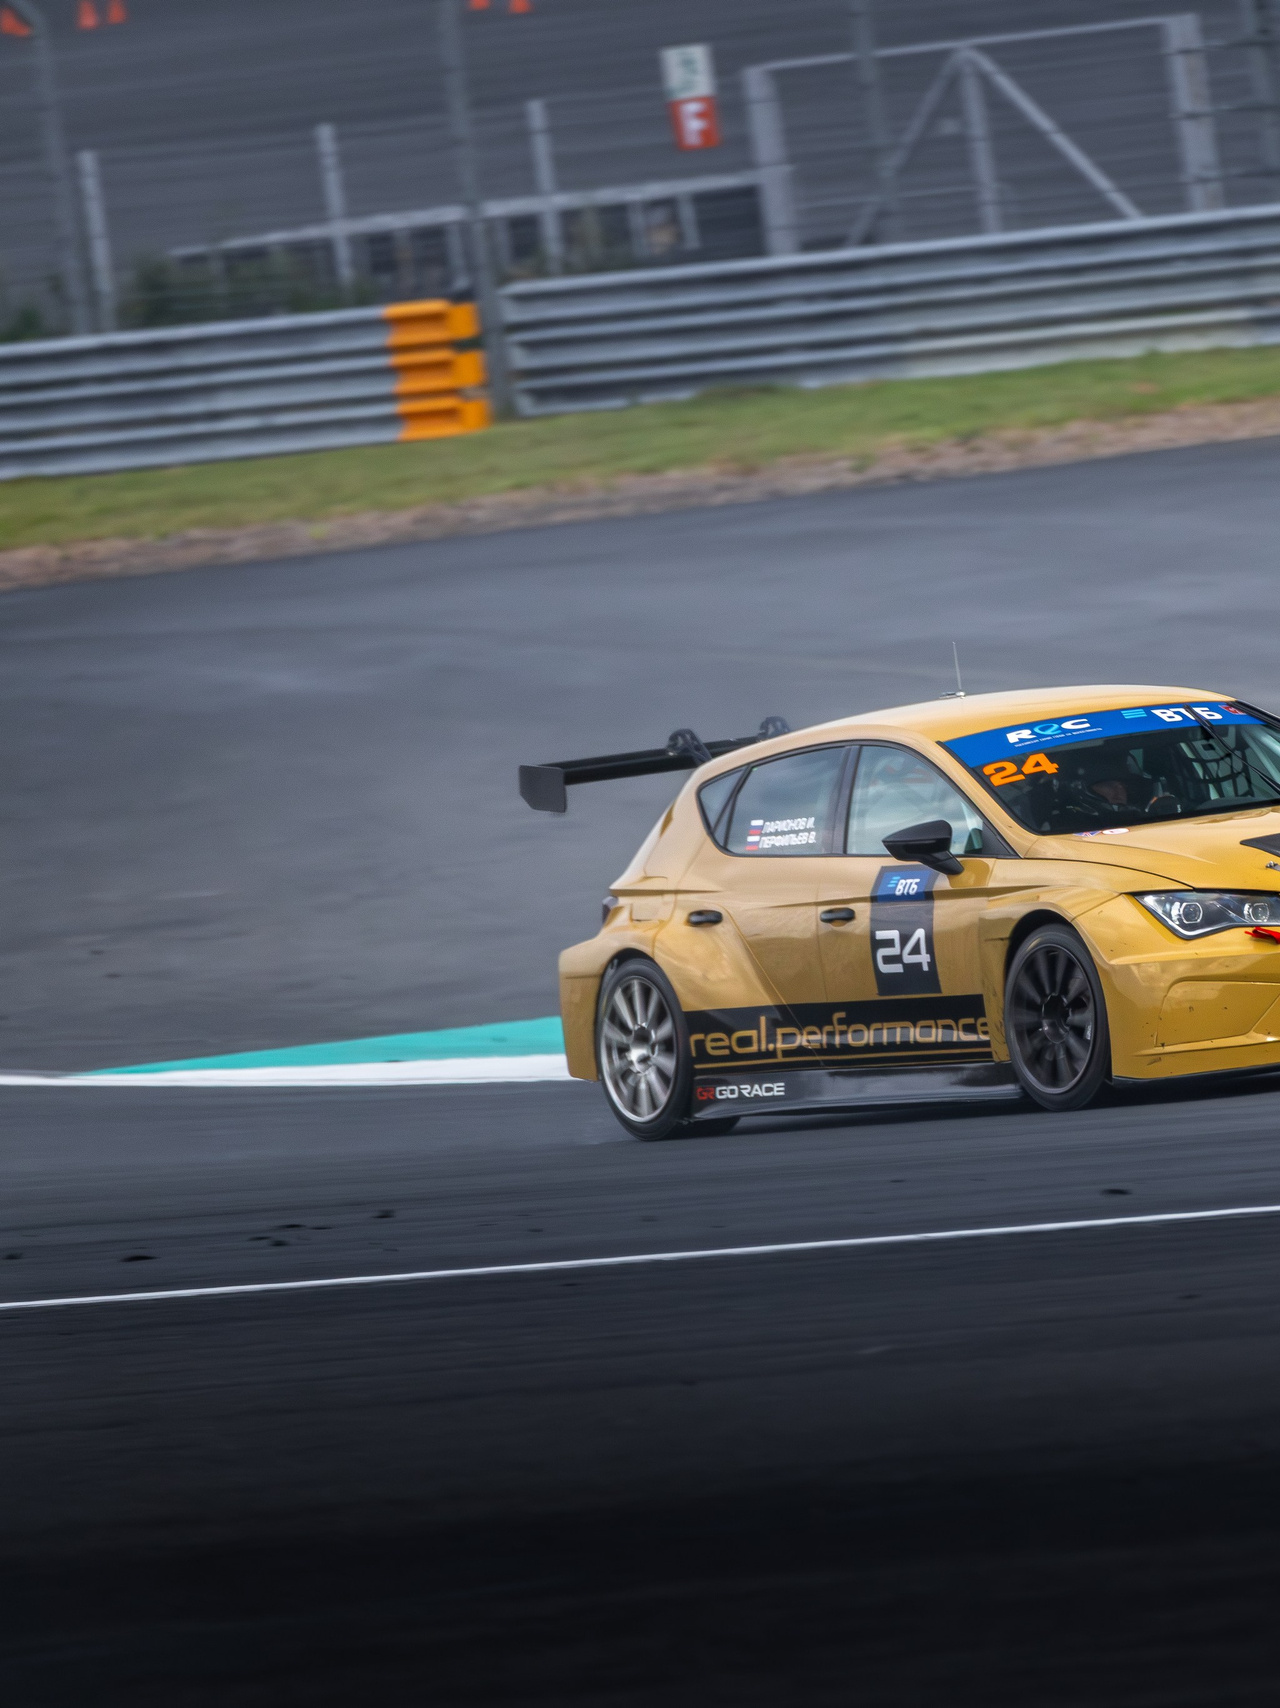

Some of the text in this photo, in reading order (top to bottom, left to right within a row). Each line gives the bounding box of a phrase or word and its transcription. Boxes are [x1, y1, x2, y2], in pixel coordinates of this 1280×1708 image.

[679, 101, 708, 146] F
[982, 752, 1059, 787] 24
[875, 928, 931, 973] 24
[715, 1085, 739, 1099] GO
[739, 1082, 785, 1097] RACE
